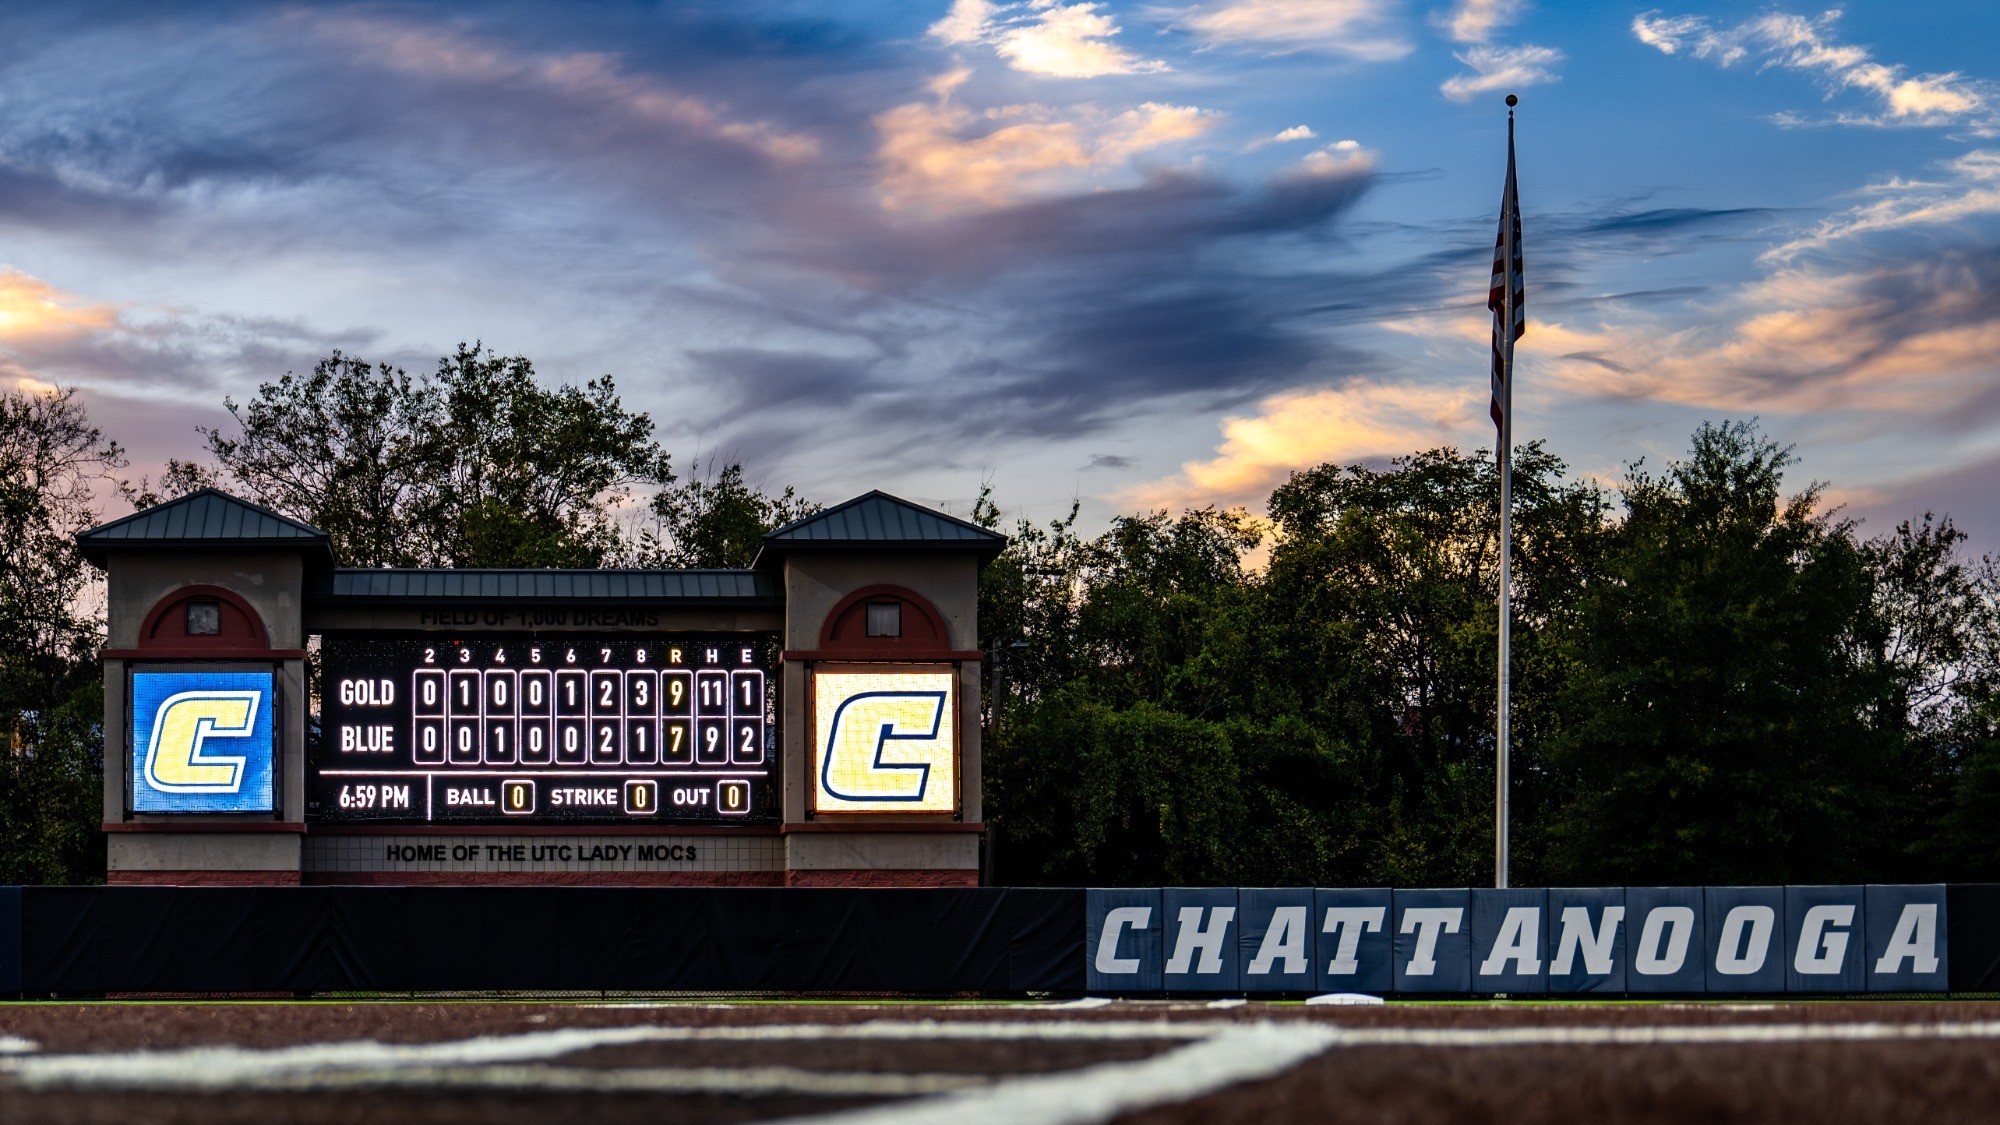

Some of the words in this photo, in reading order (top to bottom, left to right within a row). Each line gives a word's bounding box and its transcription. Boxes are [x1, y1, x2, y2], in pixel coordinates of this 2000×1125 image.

[420, 609, 477, 625] FIELD
[483, 609, 511, 625] OF
[520, 608, 567, 628] 1,000
[573, 609, 660, 626] DREAMS
[424, 648, 435, 664] 2
[459, 648, 470, 664] 3
[494, 648, 506, 664] 4
[531, 648, 541, 664] 5
[566, 648, 576, 664] 6
[601, 648, 612, 664] 7
[636, 648, 646, 664] 8
[670, 648, 682, 664] R
[706, 648, 718, 664] H
[741, 648, 752, 664] E
[340, 679, 394, 706] GOLD
[423, 680, 436, 706] 0
[459, 680, 469, 706] 1
[494, 680, 507, 706] 0
[529, 680, 542, 706] 0
[565, 680, 575, 706] 1
[600, 680, 613, 706] 2
[635, 680, 648, 706] 3
[670, 680, 683, 706] 9
[700, 680, 722, 706] 11
[741, 680, 751, 706] 1
[145, 691, 261, 793] C
[341, 725, 394, 752] BLUE
[423, 726, 436, 752] 0
[458, 726, 472, 752] 0
[494, 726, 504, 752] 1
[529, 726, 542, 752] 0
[564, 726, 578, 752] 0
[600, 726, 613, 752] 2
[636, 726, 646, 752] 1
[671, 726, 683, 752] 7
[706, 726, 719, 752] 9
[741, 726, 754, 752] 2
[821, 691, 947, 801] C
[339, 785, 377, 809] 6:59
[381, 785, 409, 808] PM
[447, 788, 496, 805] BALL
[512, 785, 524, 809] 0
[551, 788, 618, 805] STRIKE
[635, 785, 646, 809] 0
[673, 788, 711, 805] OUT
[728, 785, 740, 809] 0
[387, 845, 447, 862] HOME
[453, 845, 480, 861] OF
[486, 845, 526, 861] THE
[532, 845, 572, 862] UTC
[578, 845, 632, 861] LADY
[638, 845, 697, 862] MOCS
[1095, 904, 1939, 975] CHATTANOOGA
